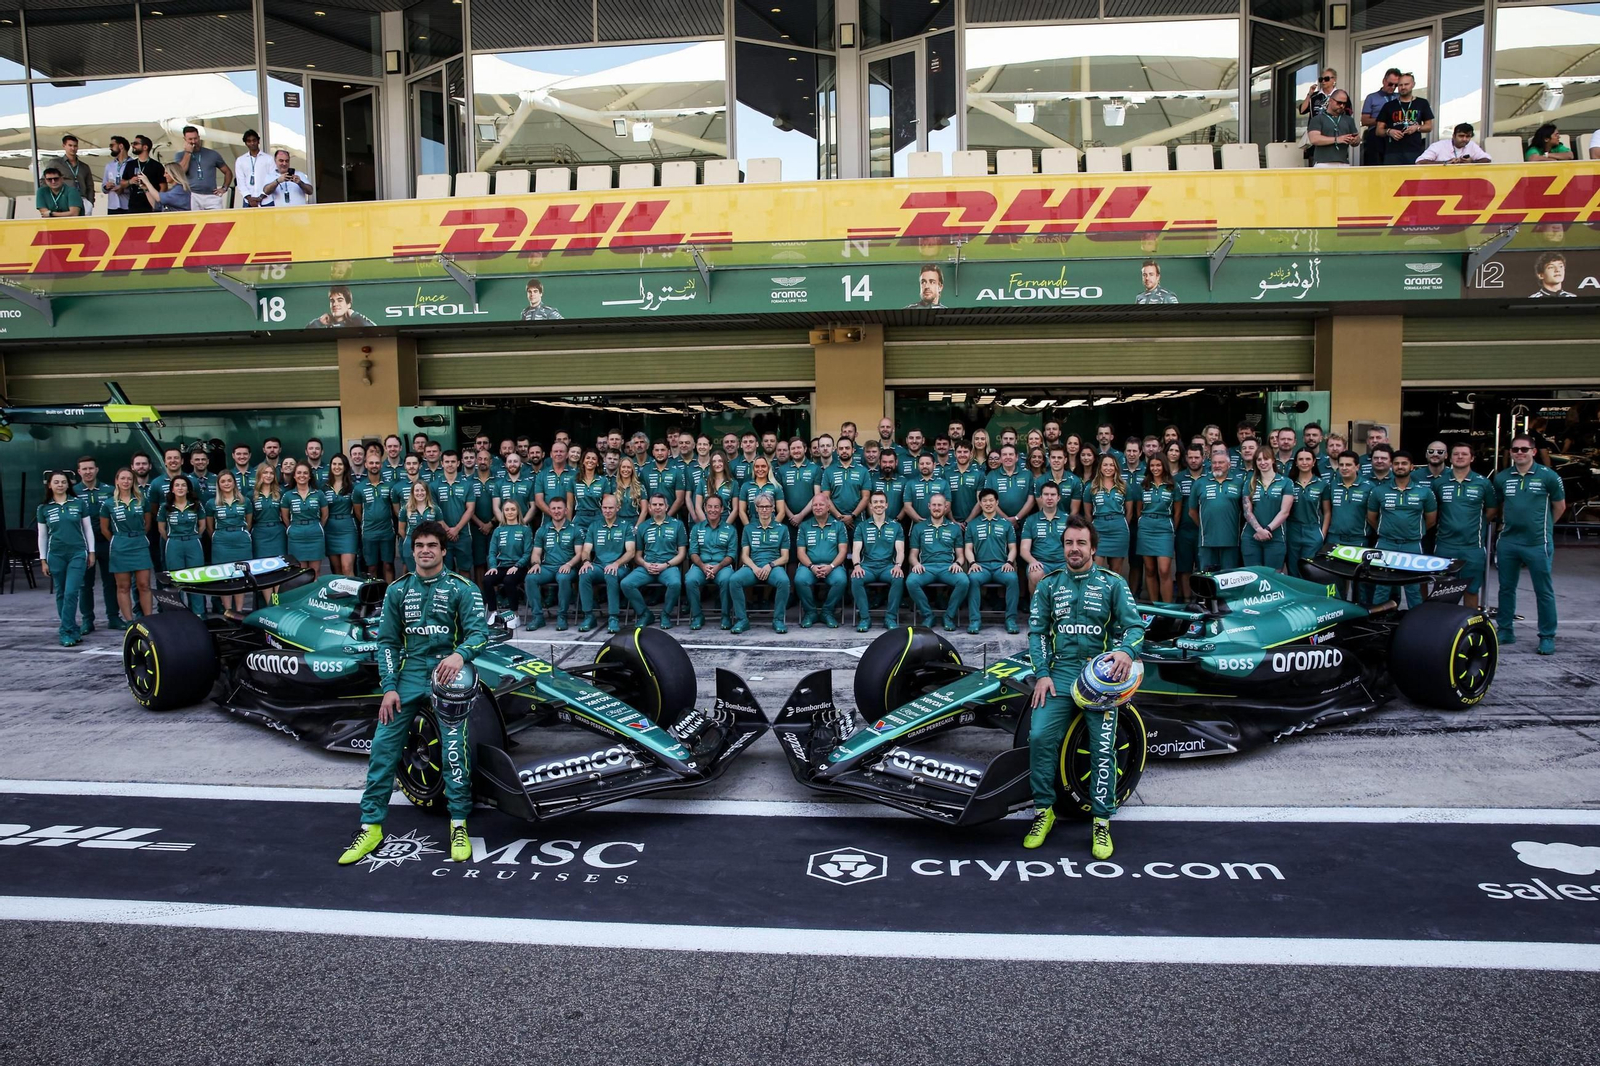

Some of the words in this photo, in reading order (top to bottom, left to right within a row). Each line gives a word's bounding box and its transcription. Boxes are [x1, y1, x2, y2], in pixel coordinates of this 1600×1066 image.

[1388, 174, 1600, 236] DH
[897, 185, 1167, 246] DHL
[438, 200, 686, 261] DHL
[26, 221, 251, 279] DHL
[1008, 265, 1068, 293] Fernando
[1404, 277, 1442, 286] aramco
[1475, 261, 1504, 288] 12
[771, 290, 808, 298] aramco
[841, 274, 872, 302] 14
[975, 286, 1103, 301] ALONSO
[414, 286, 448, 308] Lance
[259, 296, 287, 322] 18
[385, 303, 488, 318] STROLL
[1244, 590, 1285, 606] MAADEN
[1326, 584, 1336, 598] 14
[272, 593, 279, 606] 18
[308, 598, 340, 612] MAADEN
[1317, 609, 1343, 623] servicenow
[405, 625, 449, 635] aramco
[1058, 624, 1102, 635] aramco
[1178, 641, 1198, 650] BOSS
[246, 653, 299, 674] aramco
[313, 661, 343, 672] BOSS
[516, 662, 552, 676] 18
[1219, 658, 1254, 670] BOSS
[1272, 649, 1343, 673] aramco
[986, 662, 1021, 678] 14
[594, 701, 620, 711] NetApp
[725, 702, 756, 714] Bombardier
[796, 702, 832, 713] Bombardier
[909, 702, 932, 712] NetApp
[558, 711, 571, 722] FIA
[960, 714, 973, 722] FIA
[908, 717, 954, 738] GIRARD-PERREGAUX
[1099, 710, 1115, 754] MARTI
[448, 740, 463, 784] ASTON
[518, 748, 623, 786] aramco
[893, 751, 982, 787] aramc
[1095, 758, 1110, 805] ASTON
[443, 836, 645, 868] MSC
[431, 868, 630, 884] CRUISES
[910, 857, 1286, 882] crypto.com
